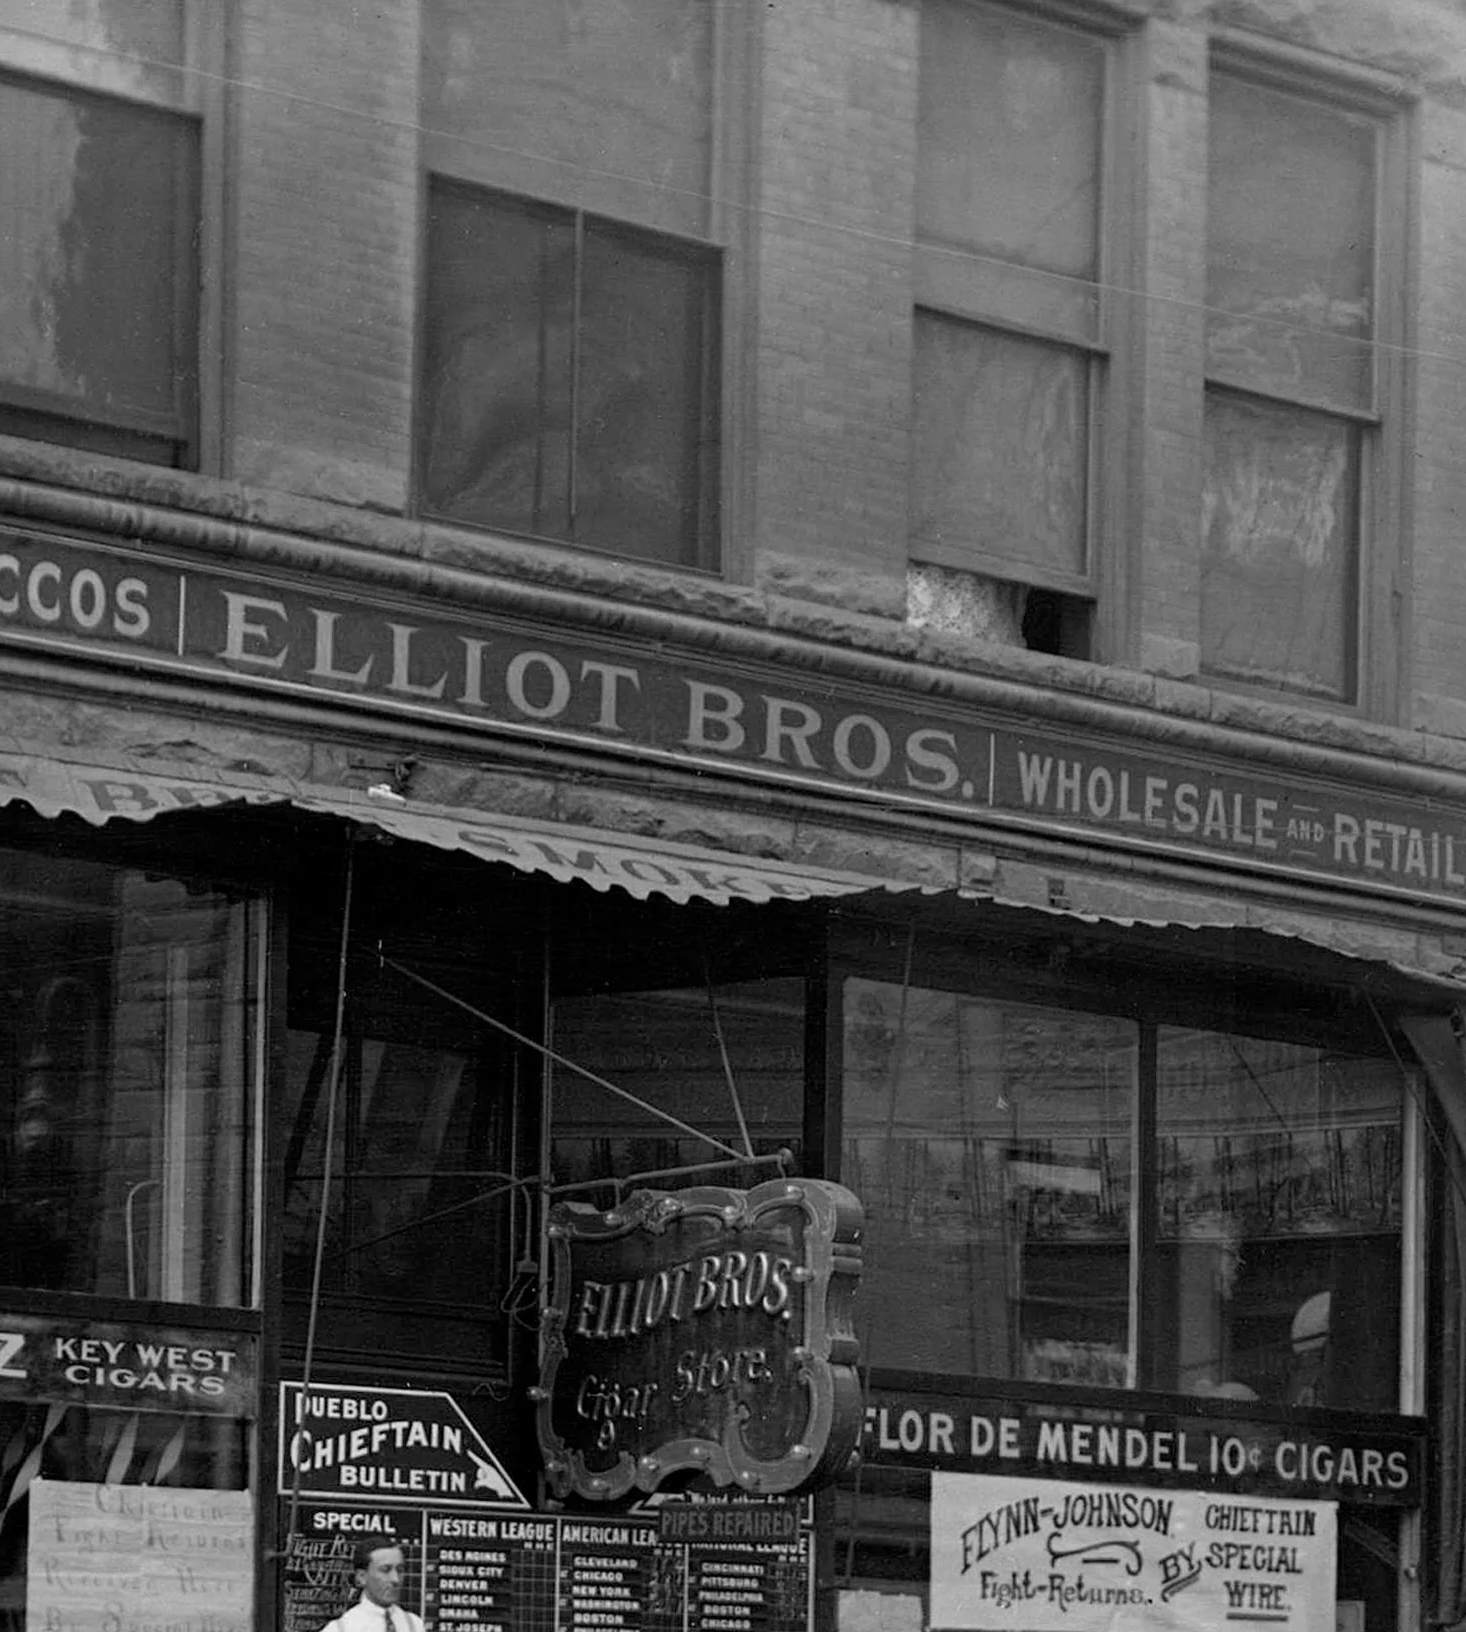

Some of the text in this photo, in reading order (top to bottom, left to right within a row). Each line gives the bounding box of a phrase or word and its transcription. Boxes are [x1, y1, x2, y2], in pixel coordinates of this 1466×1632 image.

[217, 588, 975, 798] ELLIOT BROS.
[1017, 751, 1466, 886] WHOLESALE AND RETAIL
[578, 1250, 794, 1339] ELLIOT BROS.
[55, 1335, 237, 1373] KEY WEST
[64, 1366, 226, 1397] CIGARS
[295, 1392, 388, 1425] PUEBLO
[290, 1422, 462, 1472] CHIEFTAIN
[971, 1415, 1021, 1459] DE
[1036, 1423, 1198, 1473] MENDEL
[1275, 1441, 1409, 1490] CIGARS
[340, 1466, 466, 1493] BULLETIN
[313, 1512, 396, 1533] SPECIAL
[430, 1518, 554, 1541] WESTERN LEAGUE
[562, 1525, 629, 1544] AMERICAN
[661, 1510, 794, 1536] PIPES REPAIRED
[1205, 1502, 1316, 1538] CHIEFTAIN
[477, 1566, 505, 1578] CITY
[574, 1556, 638, 1569] CLEVELAND
[1205, 1542, 1303, 1575] SPECIAL
[572, 1585, 631, 1597] NEW YORK
[574, 1571, 623, 1582] CHICAGO
[441, 1594, 494, 1606] LINCOLN
